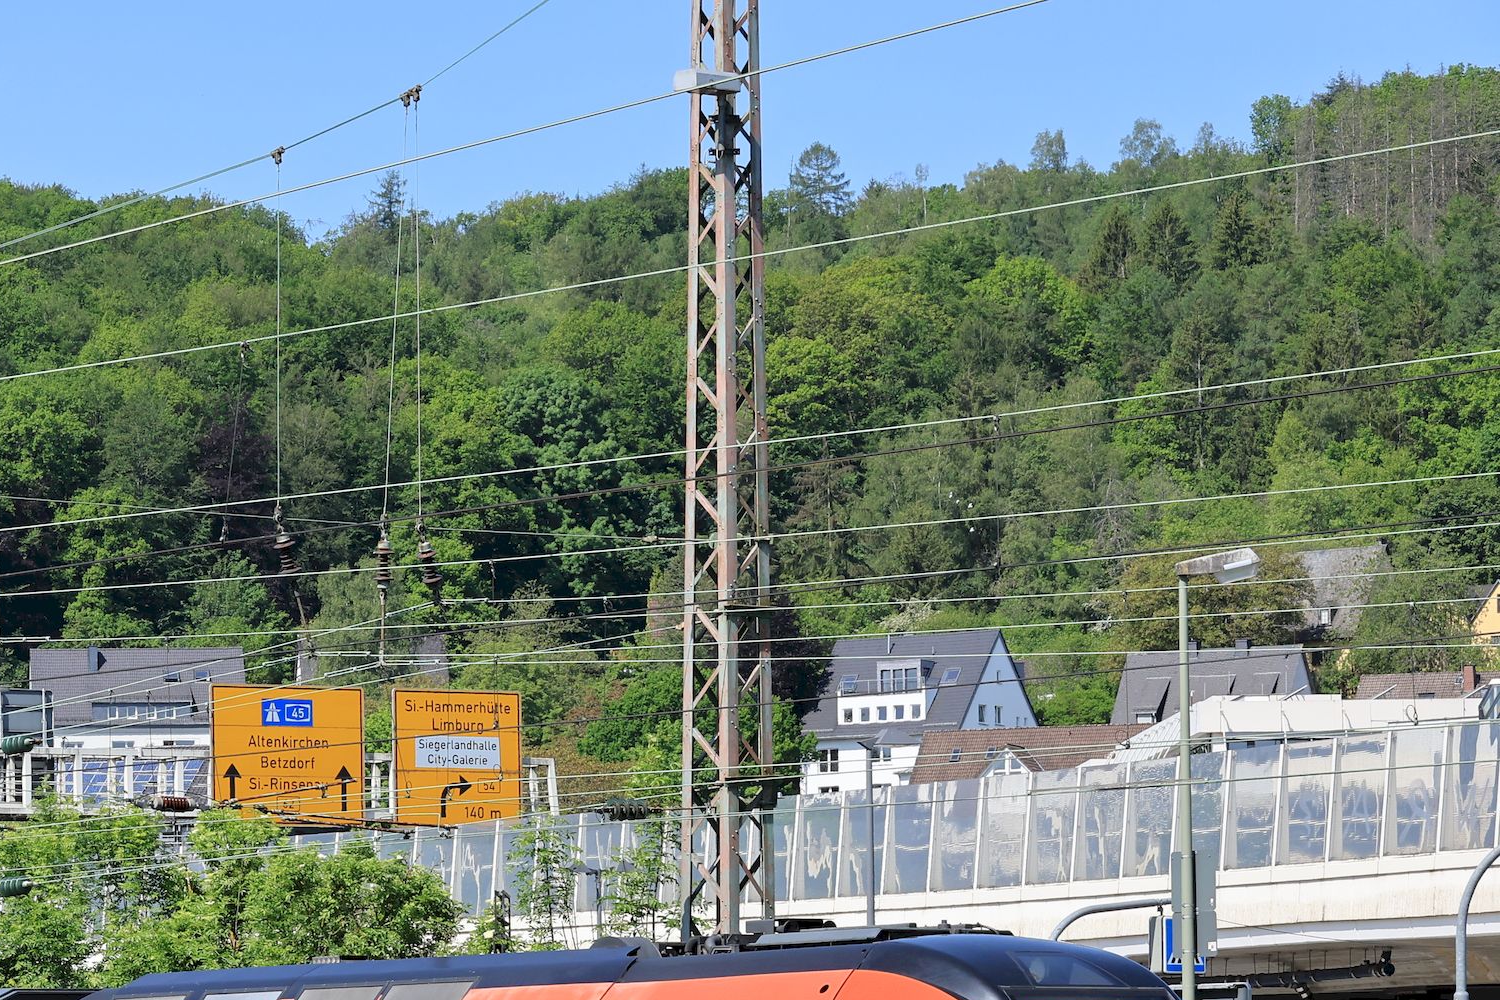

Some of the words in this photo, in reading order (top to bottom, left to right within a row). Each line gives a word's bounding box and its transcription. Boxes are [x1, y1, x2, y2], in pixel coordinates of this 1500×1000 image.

[405, 699, 511, 714] Si.-Hammerhütte
[291, 707, 304, 719] 45
[432, 718, 484, 734] Limburg
[248, 735, 329, 749] Altenkirchen
[418, 739, 497, 751] Siegerlandhalle
[260, 756, 316, 769] Betzdorf
[427, 754, 488, 766] City-Galerie
[483, 782, 495, 791] 54
[464, 806, 485, 818] 140
[490, 809, 502, 818] m
